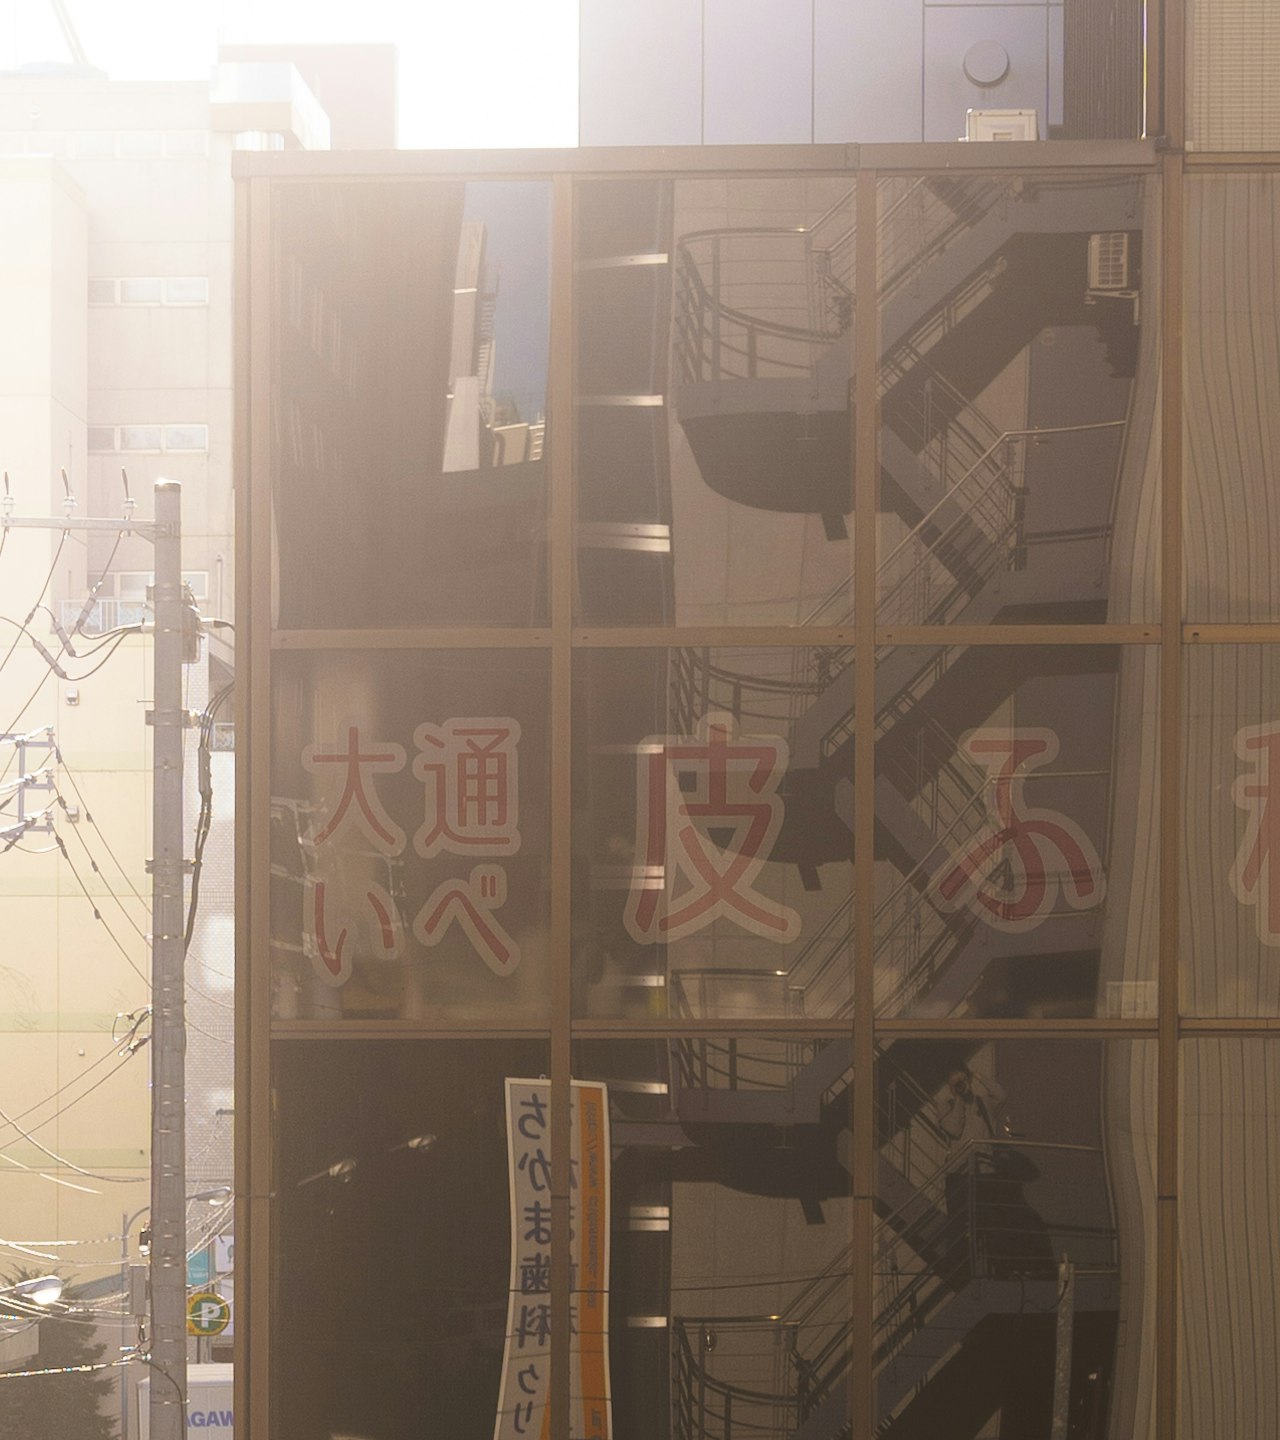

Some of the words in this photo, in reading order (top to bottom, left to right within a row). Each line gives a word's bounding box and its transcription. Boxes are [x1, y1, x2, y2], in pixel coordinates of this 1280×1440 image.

[303, 717, 520, 857] 大通
[303, 864, 520, 987] いべ
[201, 1302, 221, 1329] P
